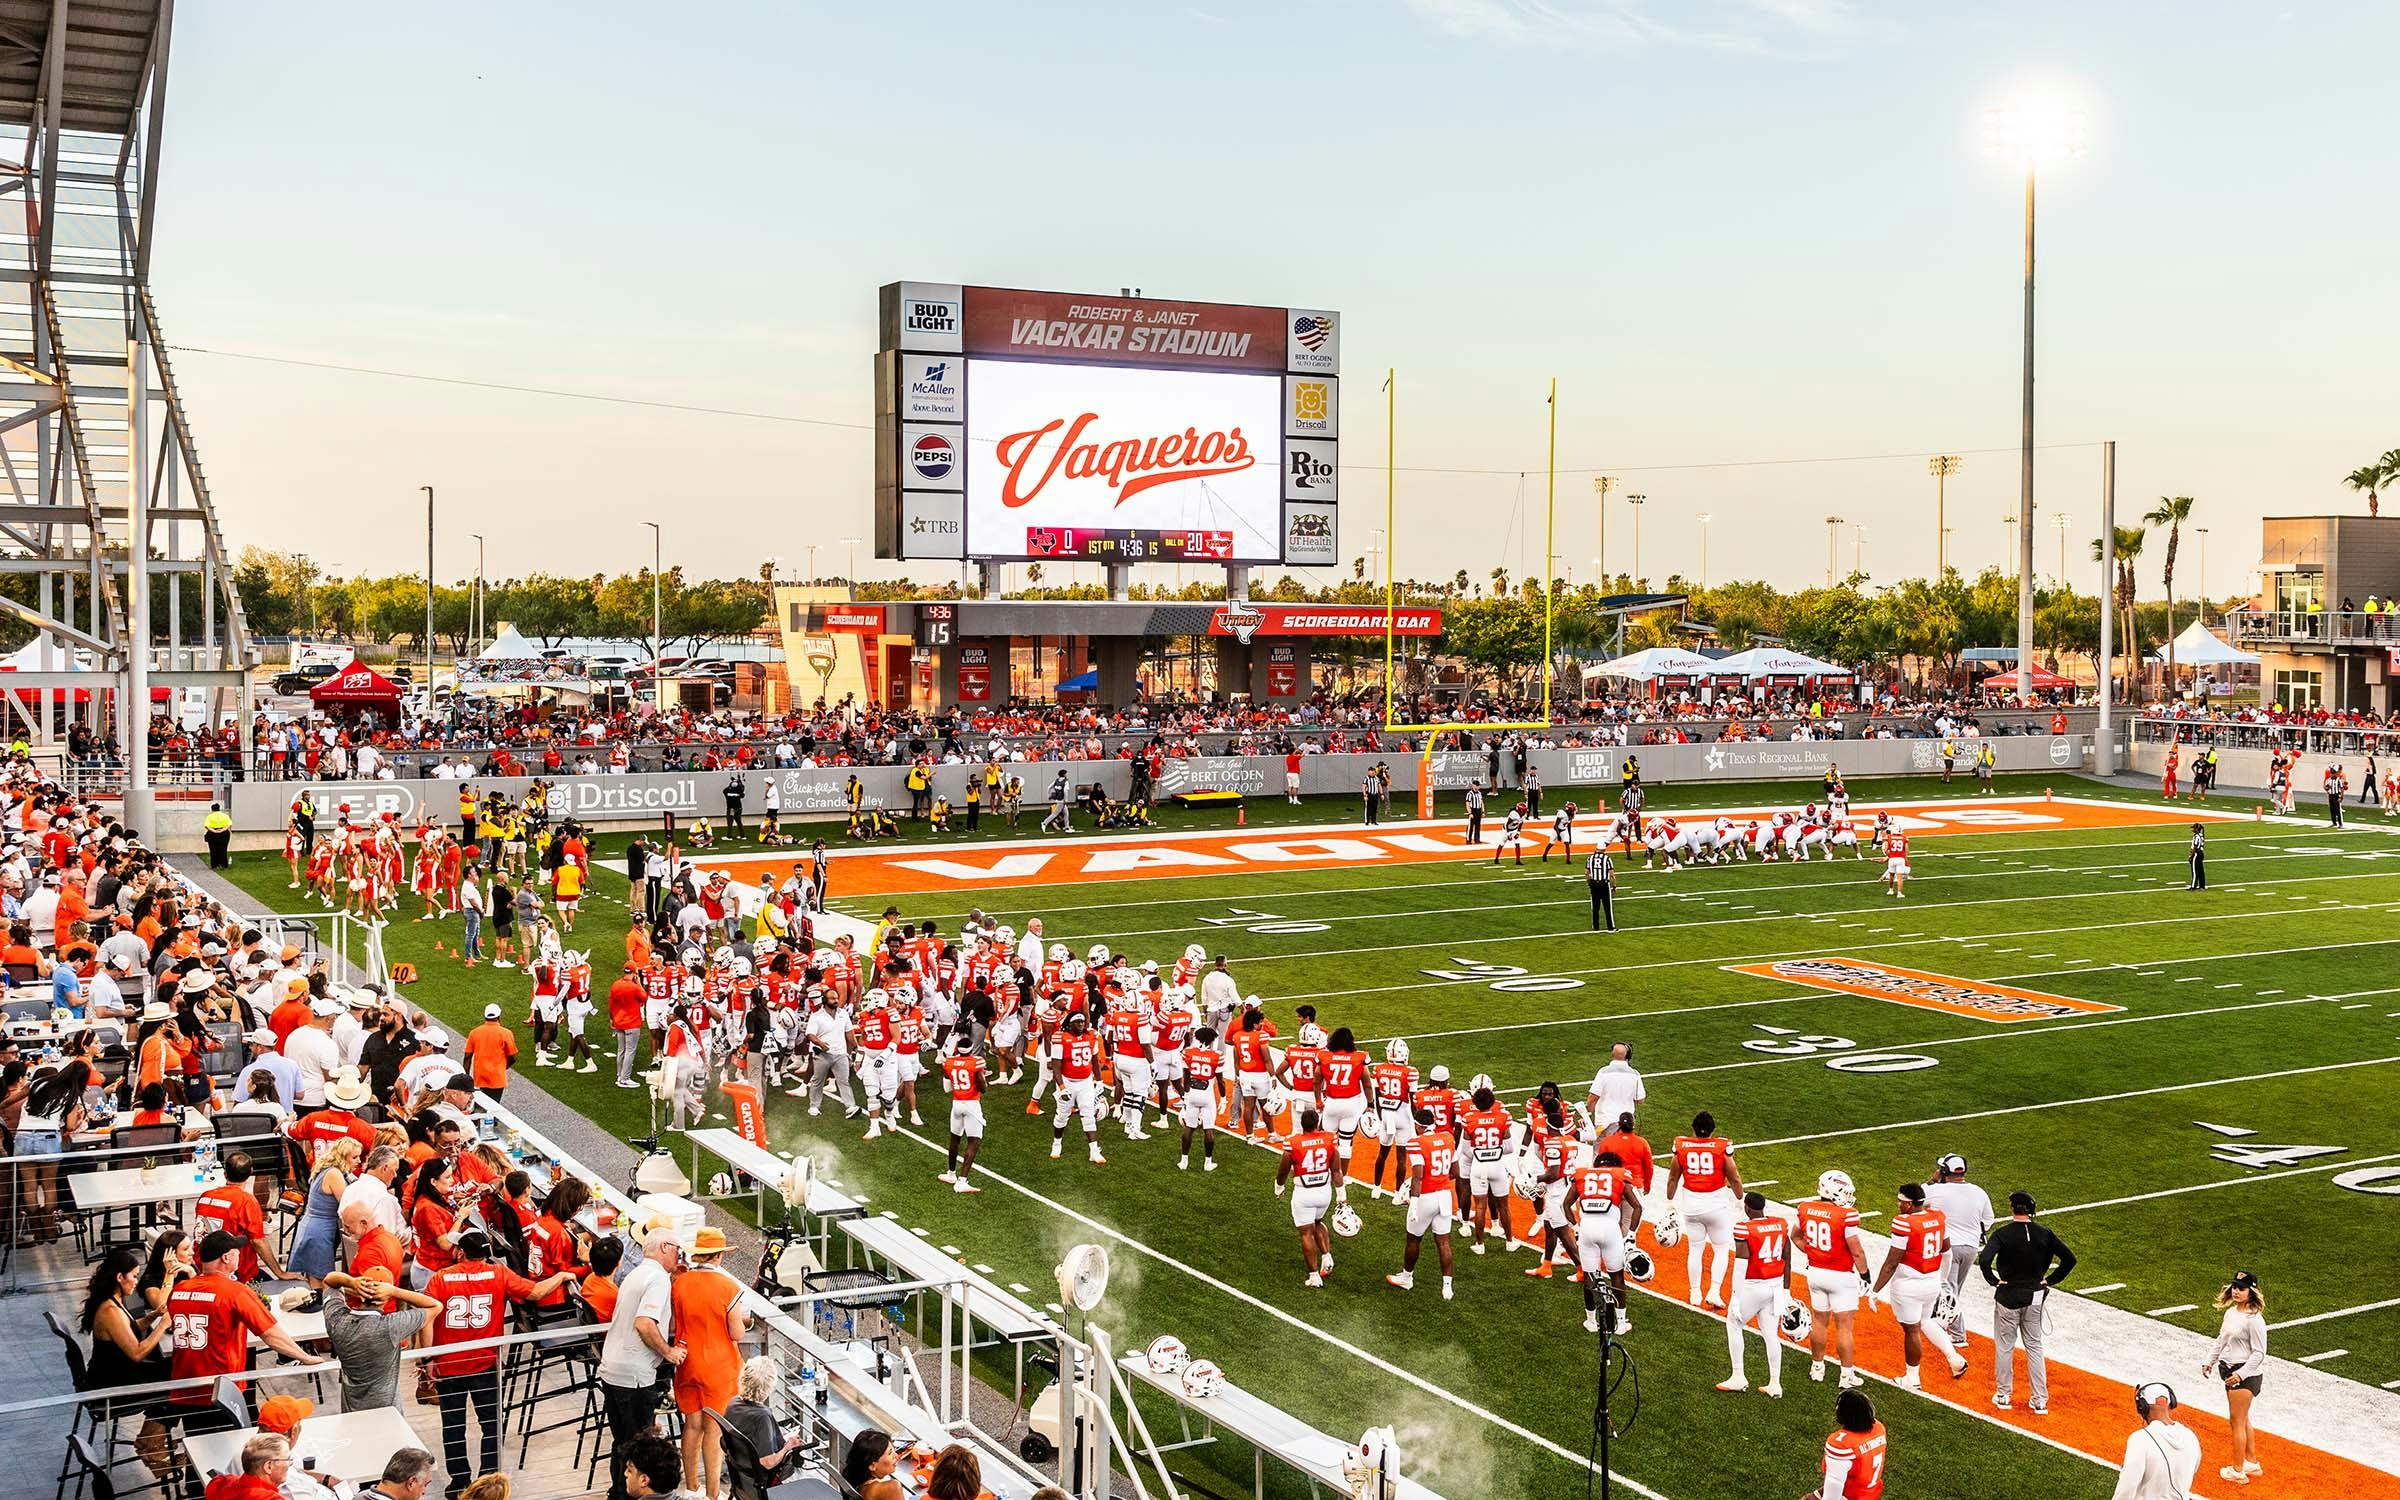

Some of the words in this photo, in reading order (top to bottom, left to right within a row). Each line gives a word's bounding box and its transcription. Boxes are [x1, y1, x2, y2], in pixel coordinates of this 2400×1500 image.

[914, 303, 949, 317] BUD
[1067, 304, 1131, 323] ROBERT
[1132, 309, 1144, 323] &
[1147, 311, 1199, 326] JANET
[908, 316, 955, 331] LIGHT
[1010, 318, 1125, 350] VACKAR
[1128, 326, 1252, 358] STADIUM
[1295, 353, 1309, 361] BERT
[1310, 354, 1332, 362] OGDEN
[912, 382, 955, 395] McAllen
[1295, 419, 1327, 430] Driscoll
[914, 451, 952, 462] PEPSI
[996, 412, 1255, 509] Vaqueros
[1290, 451, 1333, 489] Rio
[928, 520, 958, 534] TRB
[1064, 530, 1073, 550] 0
[1088, 540, 1103, 554] 1ST
[1119, 539, 1143, 556] 4:36
[1149, 542, 1158, 555] 15
[1187, 532, 1203, 552] 20
[1290, 537, 1302, 545] UT
[1302, 536, 1332, 546] Health
[827, 614, 865, 626] SCOREBOARD
[865, 615, 878, 626] BAR
[929, 605, 952, 619] 4:36
[1219, 614, 1260, 627] UTRGV
[1283, 615, 1392, 629] SCOREBOARD
[1396, 616, 1431, 628] BAR
[930, 623, 950, 644] 15
[961, 656, 988, 664] LIGHT
[965, 648, 985, 657] BUD
[1271, 655, 1295, 663] LIGHT
[1274, 647, 1292, 656] BUD
[1575, 753, 1605, 767] BUD
[1191, 770, 1218, 782] BERT
[1221, 769, 1264, 782] OGDEN
[1570, 765, 1610, 779] LIGHT
[577, 780, 698, 809] Driscoll
[1225, 782, 1263, 793] GROUP
[1425, 762, 1434, 818] UTRGV
[784, 798, 803, 809] Rio
[806, 796, 847, 808] Grande
[860, 795, 884, 807] alley
[1890, 840, 1904, 852] 39
[1593, 858, 1602, 868] R
[392, 966, 409, 981] 10
[900, 1025, 919, 1045] 32
[1071, 1046, 1093, 1067] 59
[1241, 1043, 1252, 1063] 5
[1741, 1034, 1940, 1073] 30
[1292, 1059, 1315, 1079] 43
[1329, 1063, 1353, 1086] 77
[1380, 1068, 1403, 1077] WILLIAMS
[951, 1068, 971, 1090] 19
[1379, 1076, 1402, 1097] 38
[1474, 1127, 1500, 1149] 26
[1301, 1147, 1328, 1173] 42
[1430, 1148, 1452, 1177] 58
[1686, 1151, 1715, 1175] 99
[1583, 1172, 1613, 1197] 63
[1805, 1219, 1832, 1252] 98
[1758, 1234, 1783, 1264] 44
[1922, 1230, 1942, 1260] 61
[443, 1273, 467, 1282] VACKAR
[467, 1270, 495, 1281] STADIUM
[445, 1293, 493, 1329] 25
[173, 1313, 209, 1350] 25
[1866, 1451, 1883, 1489] 7
